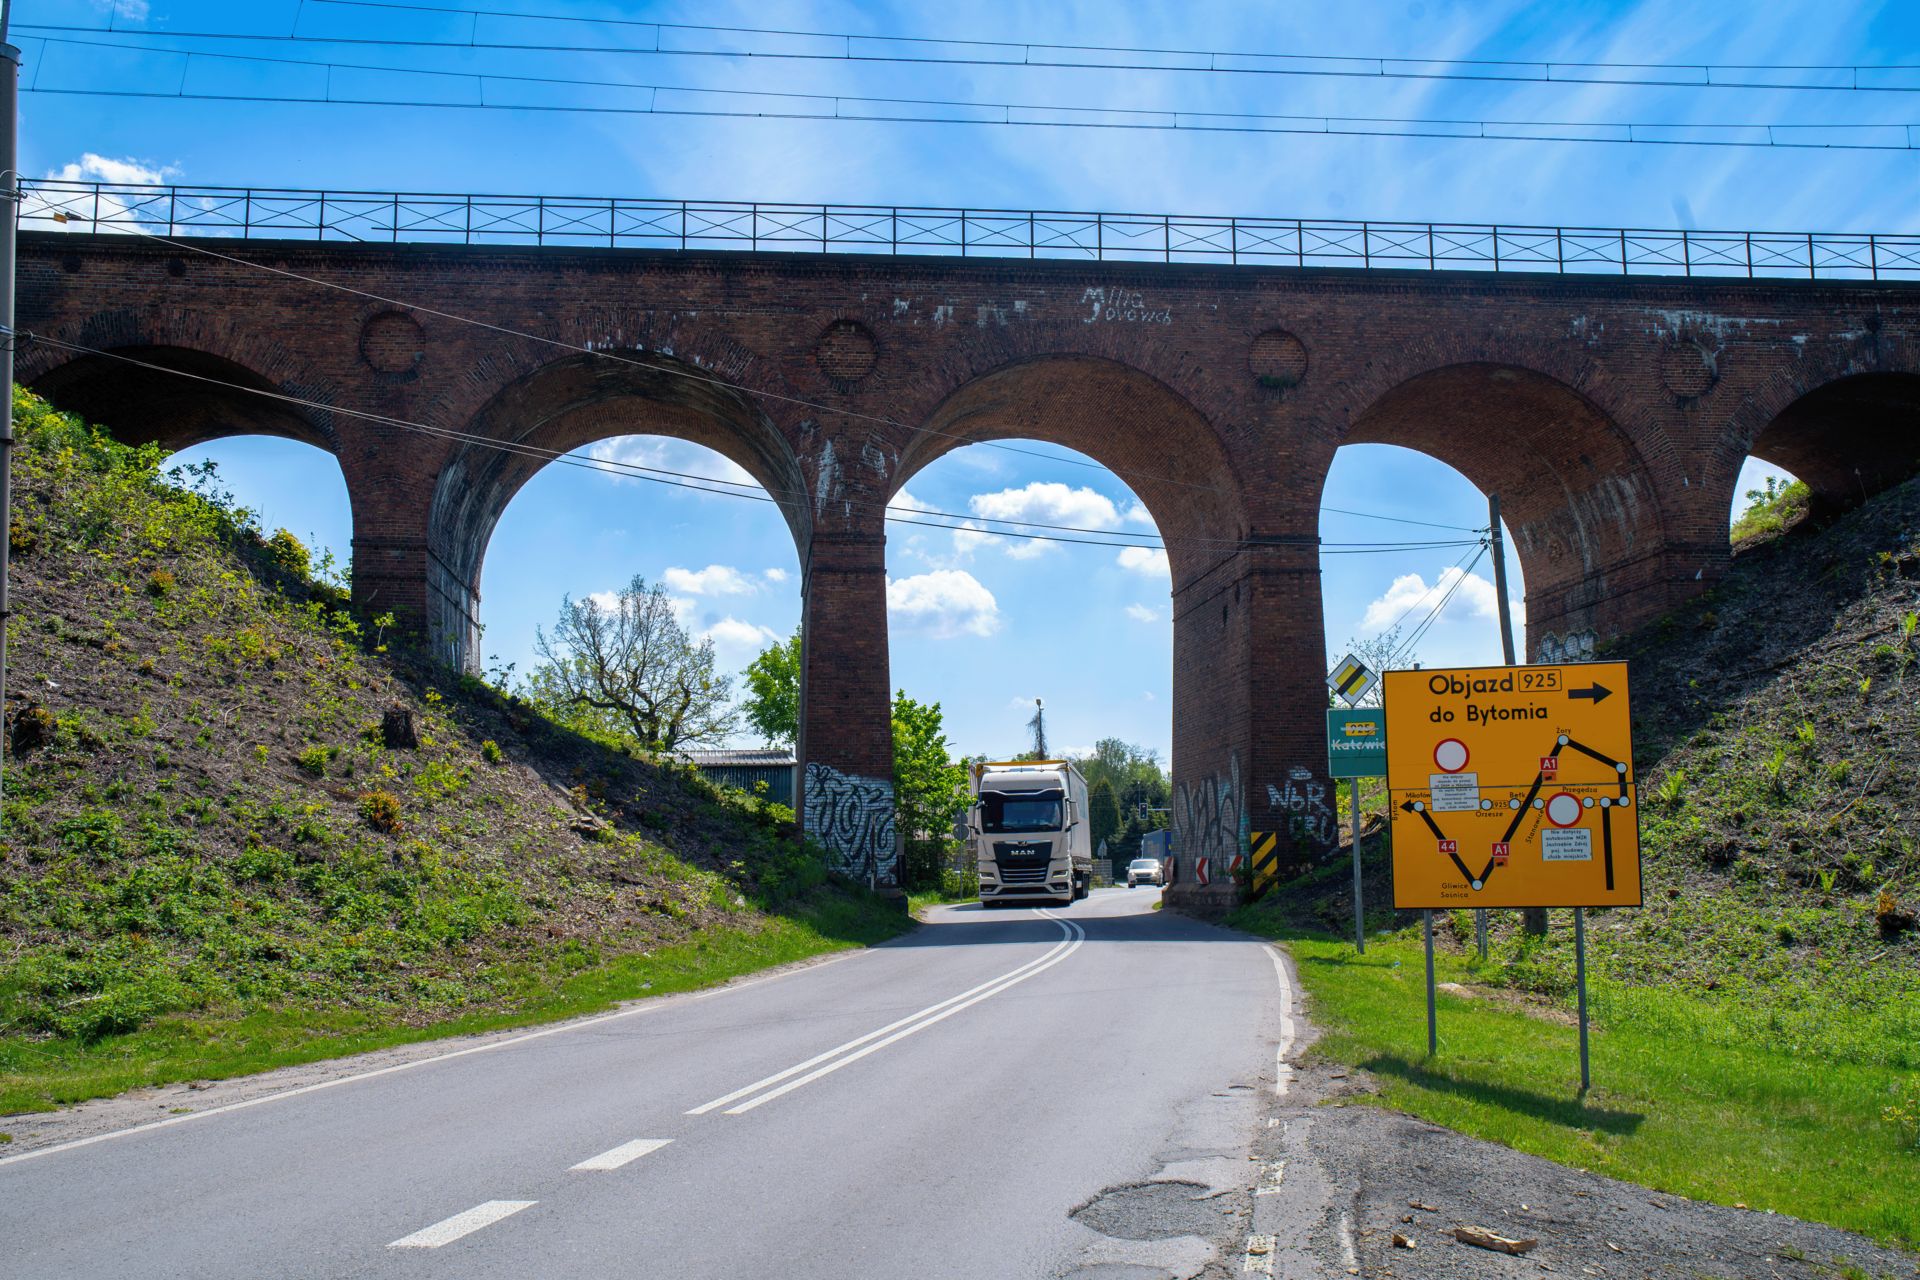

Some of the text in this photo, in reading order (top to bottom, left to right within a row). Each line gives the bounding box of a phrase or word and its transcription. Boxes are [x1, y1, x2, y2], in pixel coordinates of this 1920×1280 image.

[1429, 672, 1557, 699] Objazd 925
[1429, 702, 1548, 726] do Bytomia
[1556, 727, 1571, 735] Żory
[1543, 759, 1556, 769] A1
[1525, 809, 1544, 844] Stanowice
[1441, 842, 1455, 851] 44
[1495, 845, 1507, 855] A1
